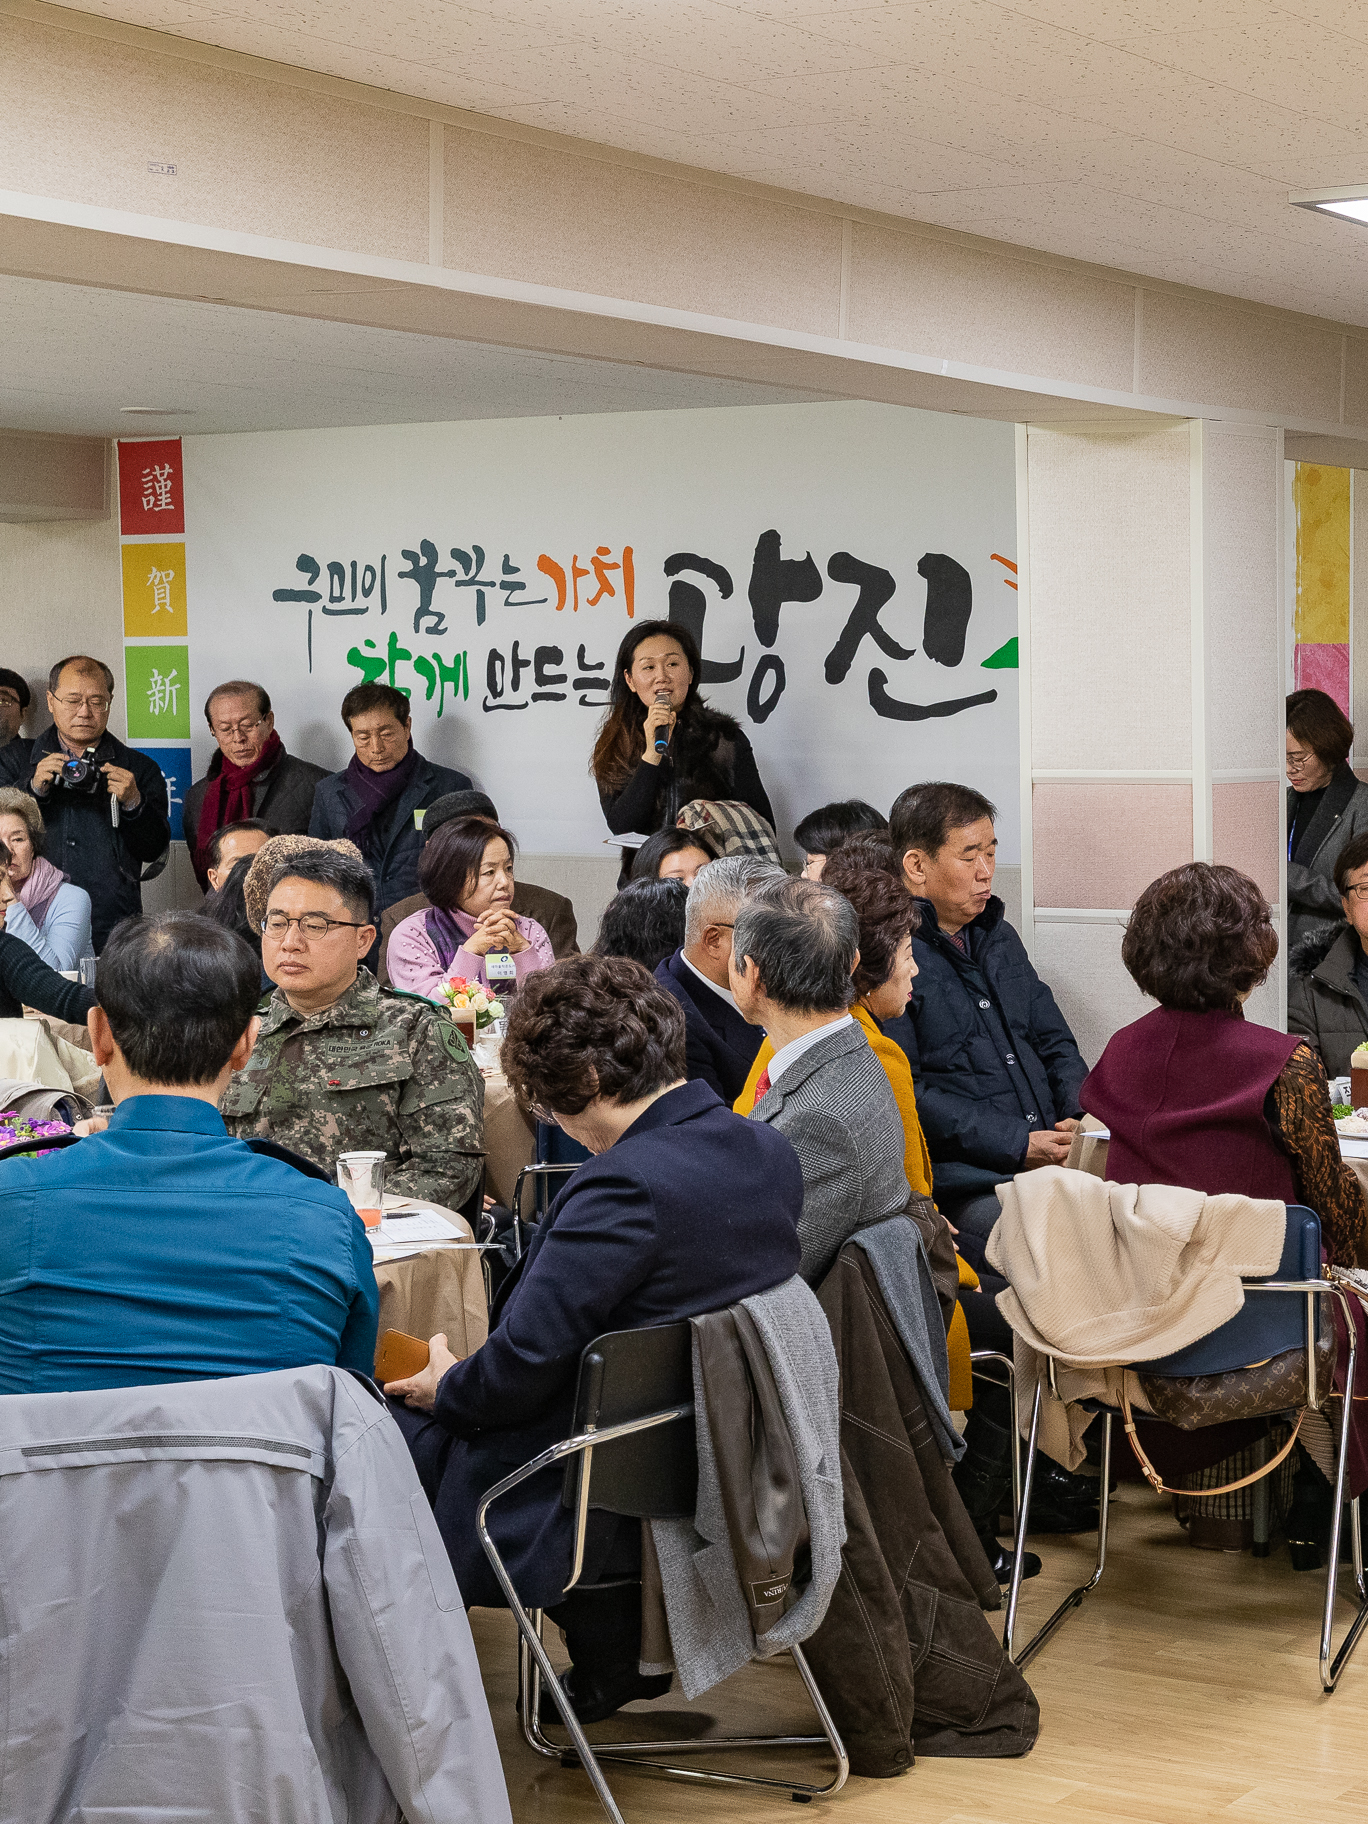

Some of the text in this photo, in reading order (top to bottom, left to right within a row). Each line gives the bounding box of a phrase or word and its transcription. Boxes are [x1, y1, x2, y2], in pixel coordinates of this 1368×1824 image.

[272, 538, 635, 674] 구민이 꿈꾸는 가치
[663, 529, 998, 725] 광진
[328, 1045, 358, 1053] 대한민국
[373, 1039, 391, 1047] ROKA
